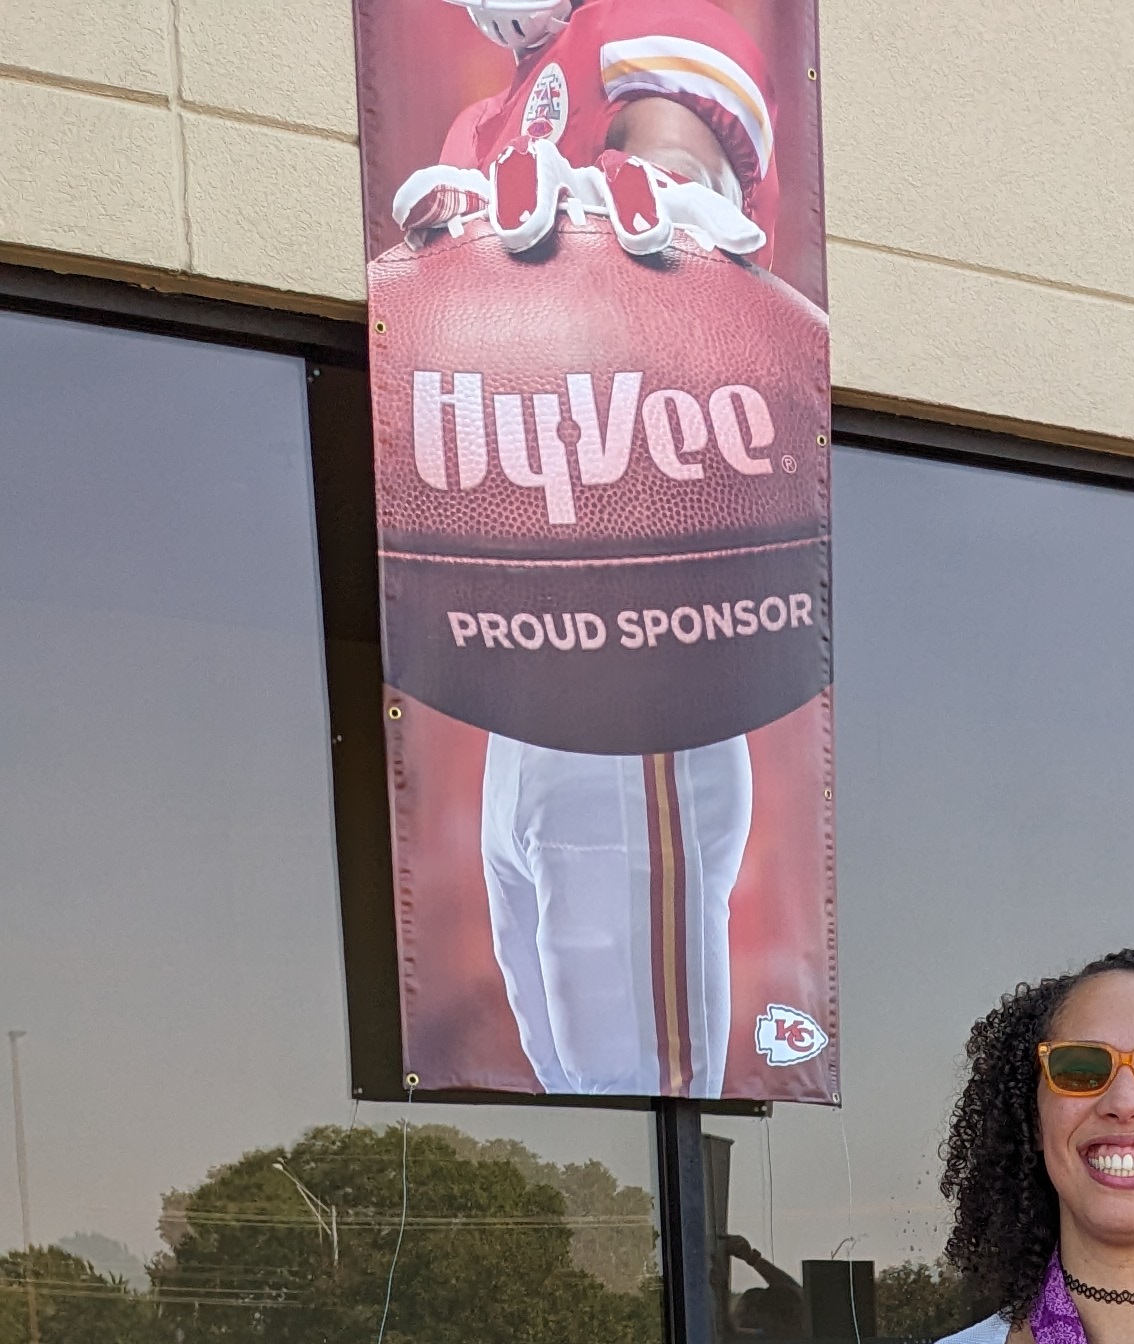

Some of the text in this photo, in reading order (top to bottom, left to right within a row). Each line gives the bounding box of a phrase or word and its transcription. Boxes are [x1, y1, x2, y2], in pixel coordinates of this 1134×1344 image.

[447, 592, 814, 652] PROUD SPONSOR
[774, 1018, 815, 1053] KC
